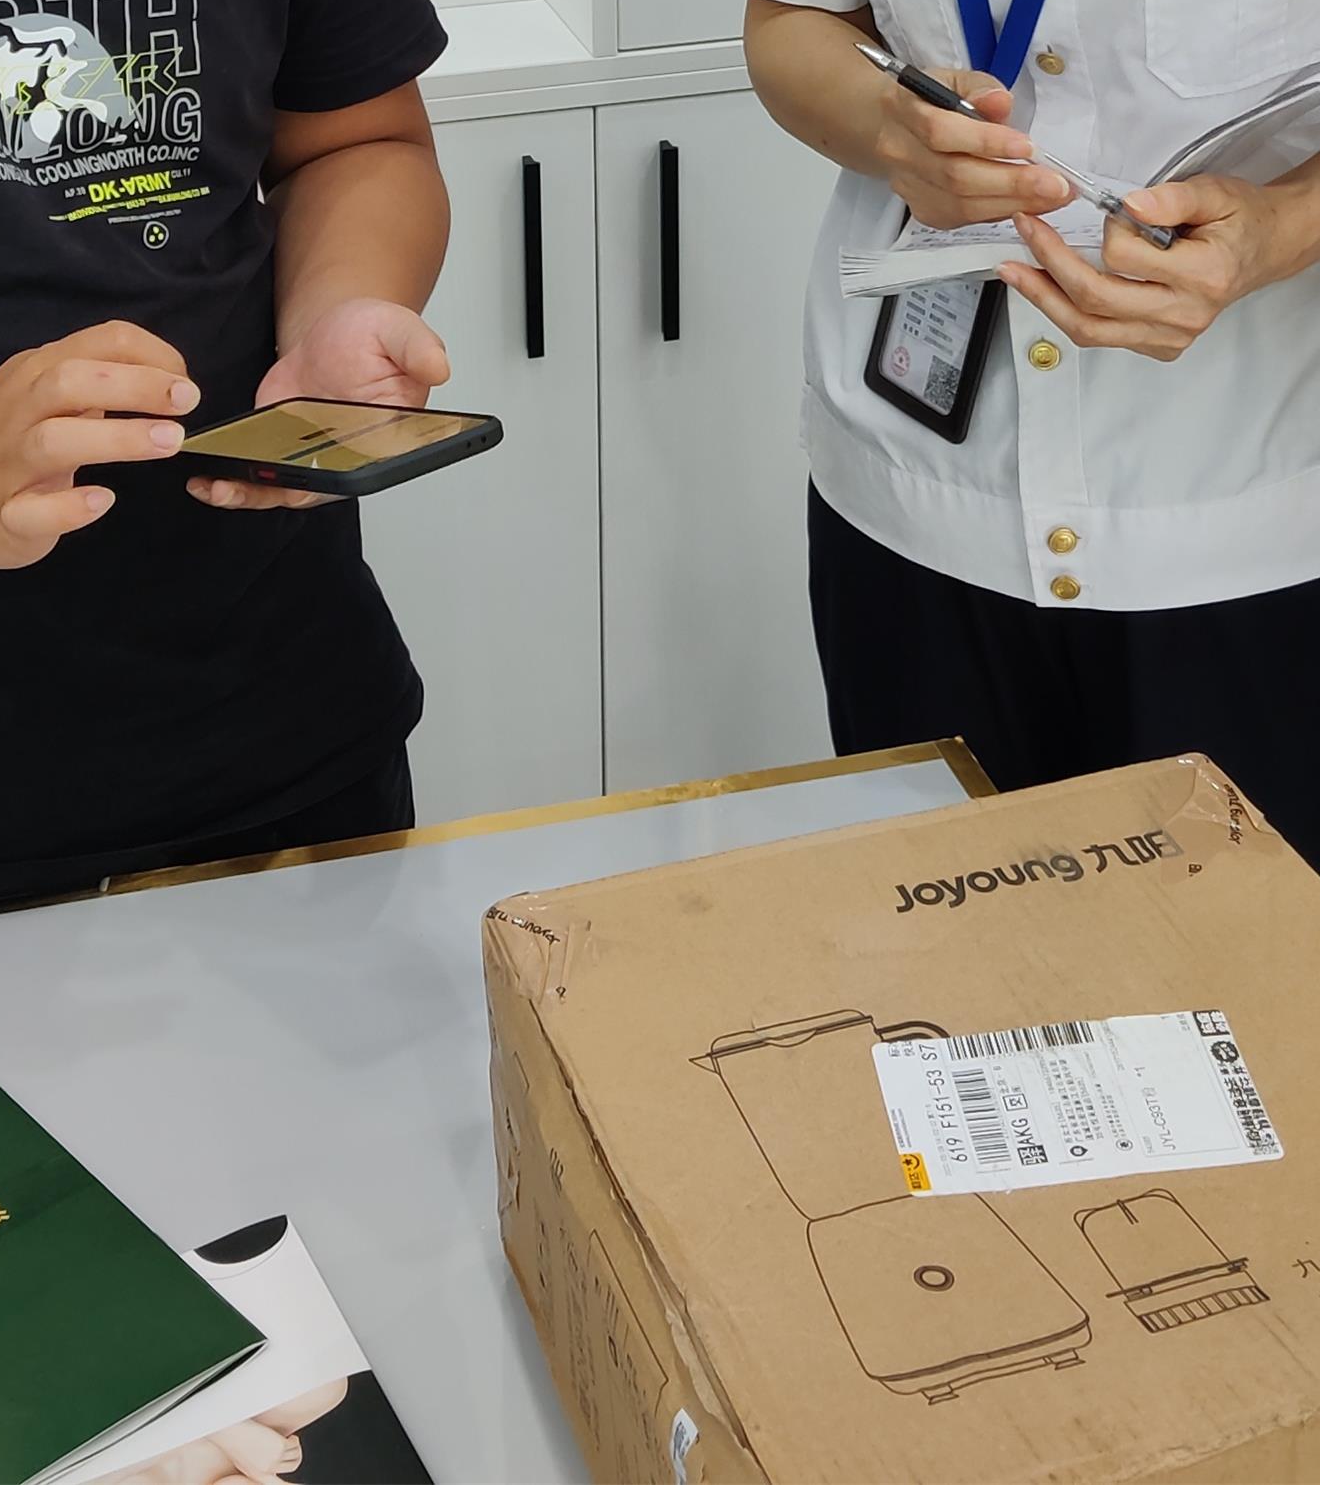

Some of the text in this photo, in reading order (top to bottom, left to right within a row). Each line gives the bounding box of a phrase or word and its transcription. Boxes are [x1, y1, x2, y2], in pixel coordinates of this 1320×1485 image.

[895, 854, 1084, 914] Joyoung
[919, 1043, 938, 1061] S7
[926, 1069, 958, 1130] F151-53
[1011, 1118, 1032, 1146] AKG
[947, 1137, 968, 1162] 619
